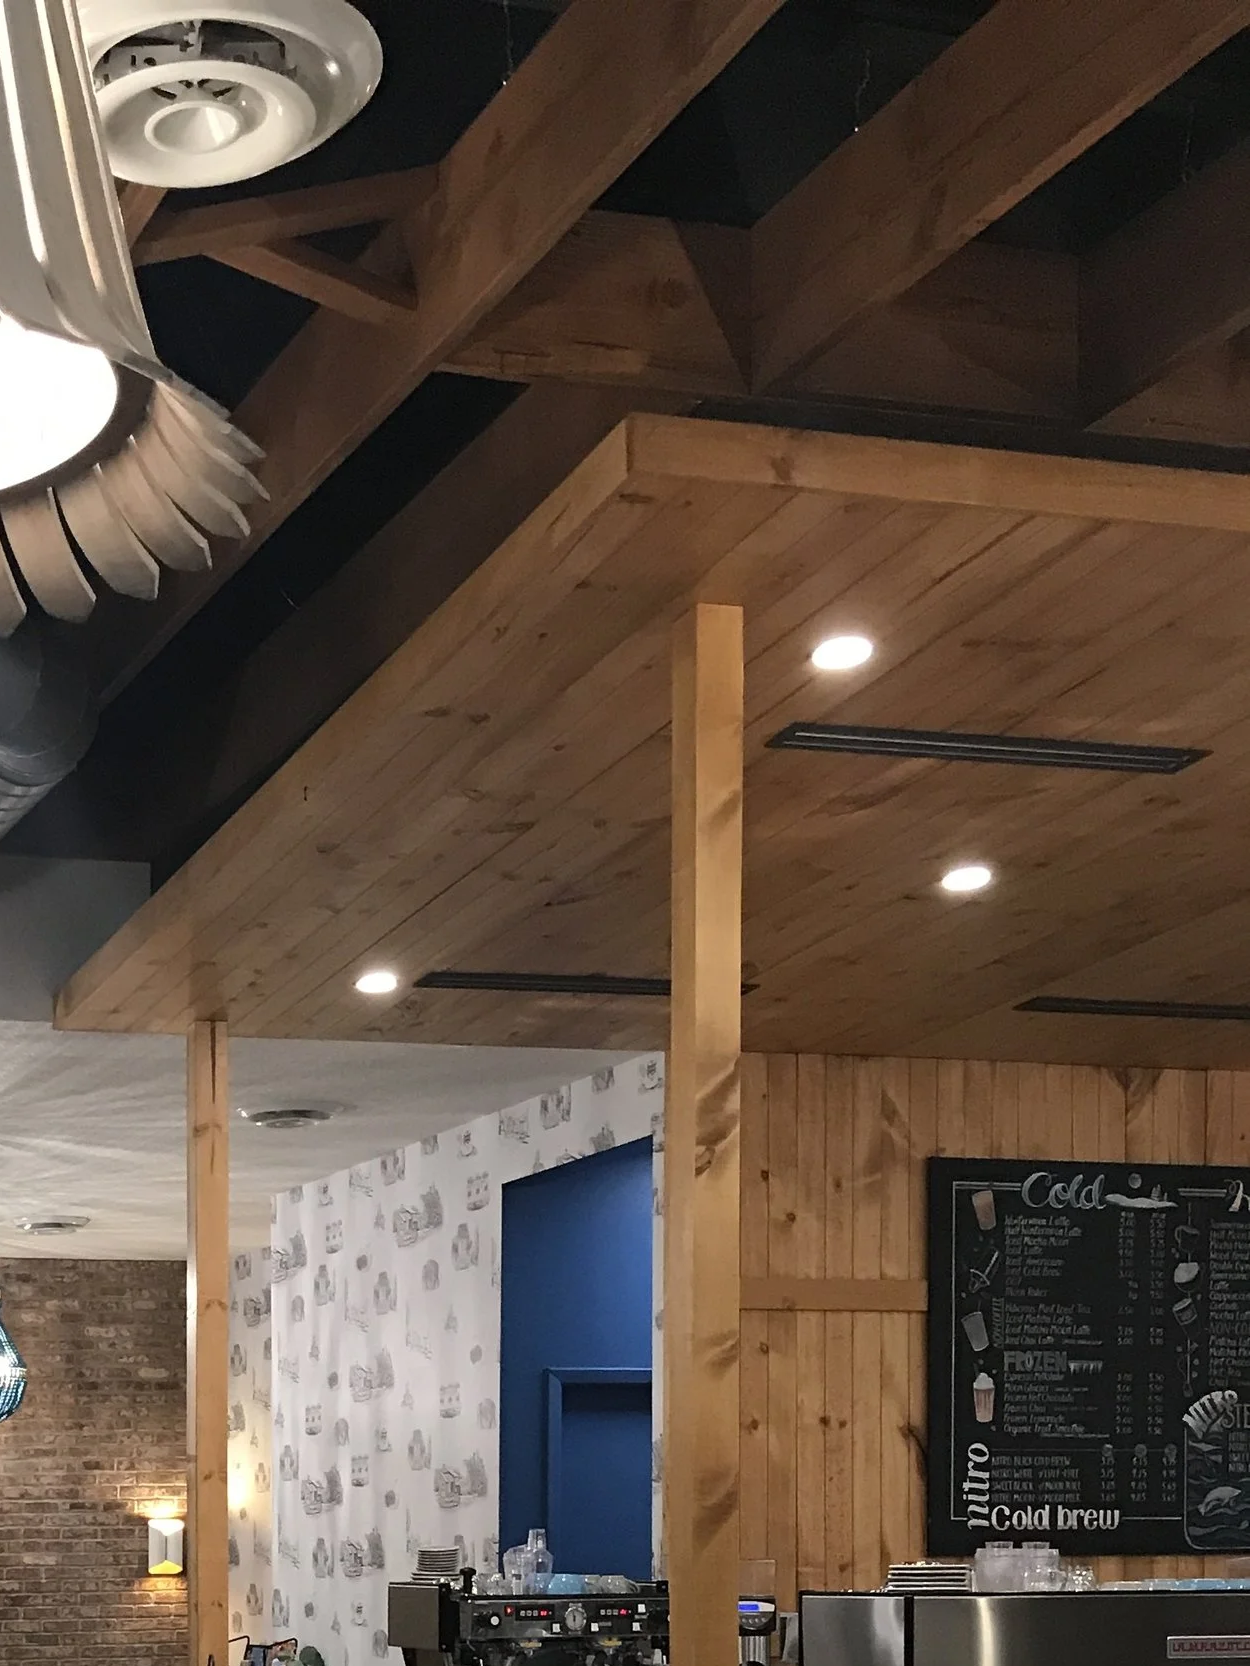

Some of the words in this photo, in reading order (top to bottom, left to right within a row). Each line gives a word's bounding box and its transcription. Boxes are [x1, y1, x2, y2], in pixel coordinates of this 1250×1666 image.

[1022, 1172, 1107, 1210] Cold
[1004, 1351, 1067, 1372] FROZEN
[963, 1443, 990, 1529] nitro
[991, 1505, 1050, 1531] Cold
[1057, 1505, 1120, 1531] brew
